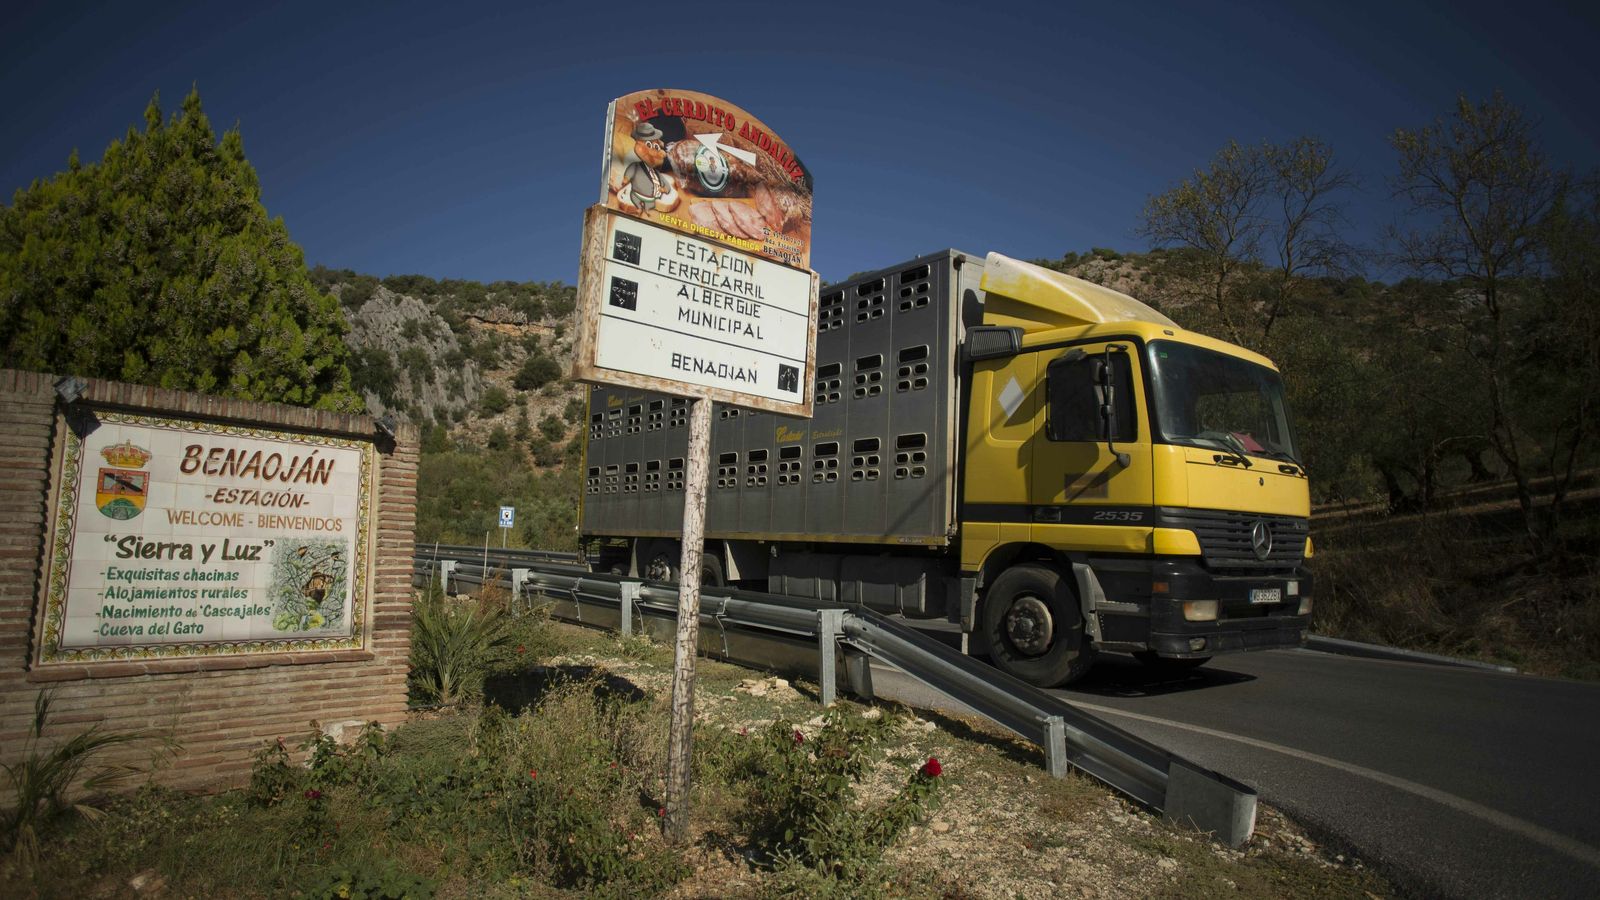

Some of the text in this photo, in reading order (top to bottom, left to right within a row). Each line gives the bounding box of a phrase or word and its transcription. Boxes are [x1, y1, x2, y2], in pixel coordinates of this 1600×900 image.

[634, 97, 805, 182] EL CERDITO ANDALUZ
[659, 213, 688, 229] VENTA
[690, 223, 725, 241] DIRECTA
[676, 240, 754, 277] ESTACION
[658, 256, 765, 300] FERROCARRIL
[677, 284, 761, 319] ALBERGUE
[678, 306, 764, 340] MUNICIPAL
[671, 352, 758, 384] BENAOJAN
[179, 444, 335, 485] BENAOJÁN
[167, 509, 244, 527] WELCOME
[257, 514, 342, 531] BIENVENIDOS
[1093, 511, 1145, 521] 2535
[201, 543, 216, 564] y
[183, 568, 240, 581] chacinas
[201, 586, 248, 599] rurales
[185, 608, 198, 618] de
[147, 622, 171, 635] del
[173, 621, 204, 635] Gato
